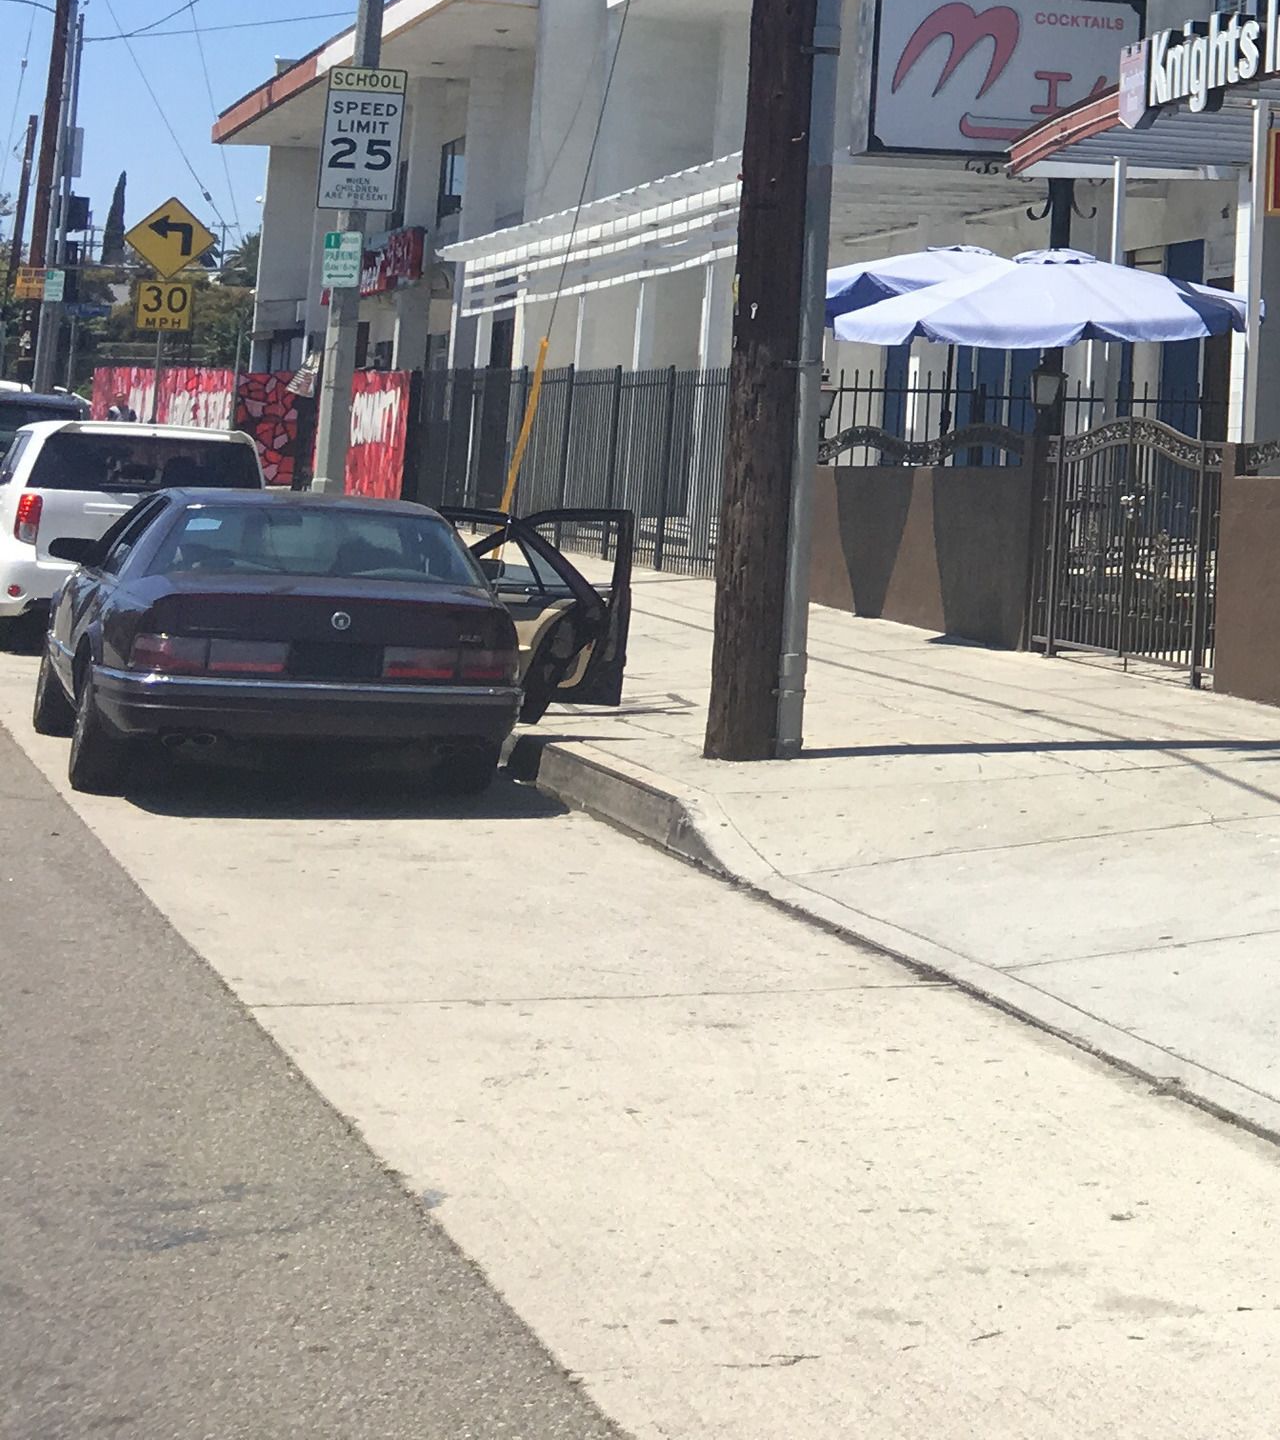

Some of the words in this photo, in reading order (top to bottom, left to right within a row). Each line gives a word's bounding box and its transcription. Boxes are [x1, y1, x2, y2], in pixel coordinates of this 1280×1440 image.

[1034, 11, 1125, 32] COCKTAILS
[1149, 10, 1260, 113] Knights
[333, 71, 402, 89] SCHOOL
[332, 100, 398, 117] SPEED
[337, 119, 390, 135] LIMIT
[327, 137, 392, 171] 25
[324, 191, 343, 200] ARE
[347, 192, 388, 201] PRESENT
[335, 184, 379, 193] CHILDREN
[142, 286, 188, 314] 30
[144, 317, 182, 329] MPH
